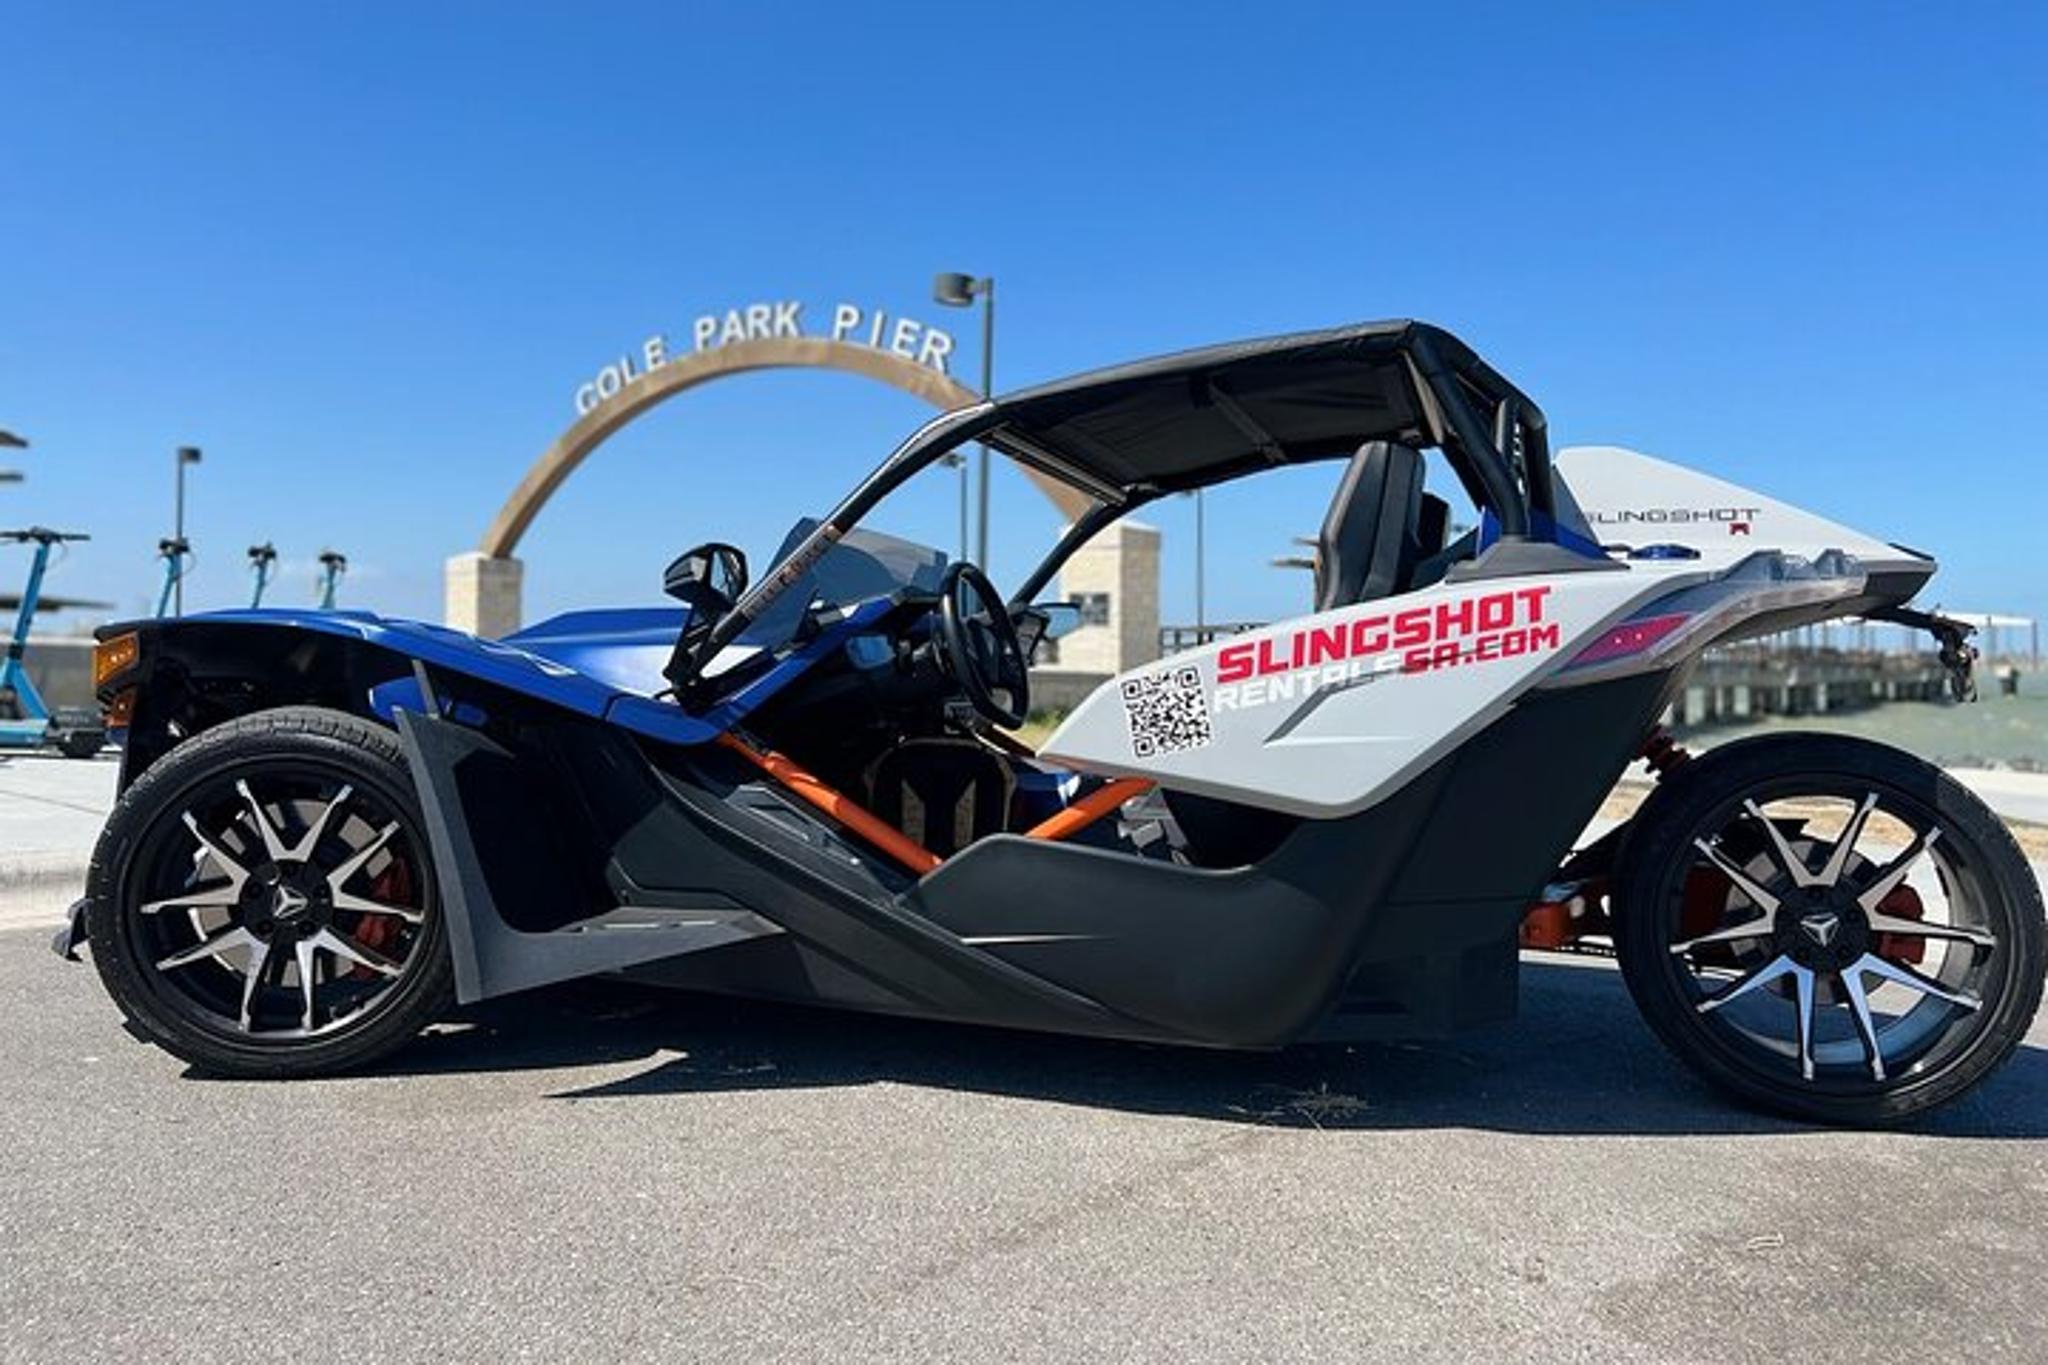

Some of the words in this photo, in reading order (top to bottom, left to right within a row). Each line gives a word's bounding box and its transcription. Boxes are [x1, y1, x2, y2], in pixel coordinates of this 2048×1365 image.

[576, 336, 668, 416] COLE
[694, 302, 800, 351] PARK
[833, 304, 953, 373] PIER
[1217, 585, 1551, 684] SLINGSHOT
